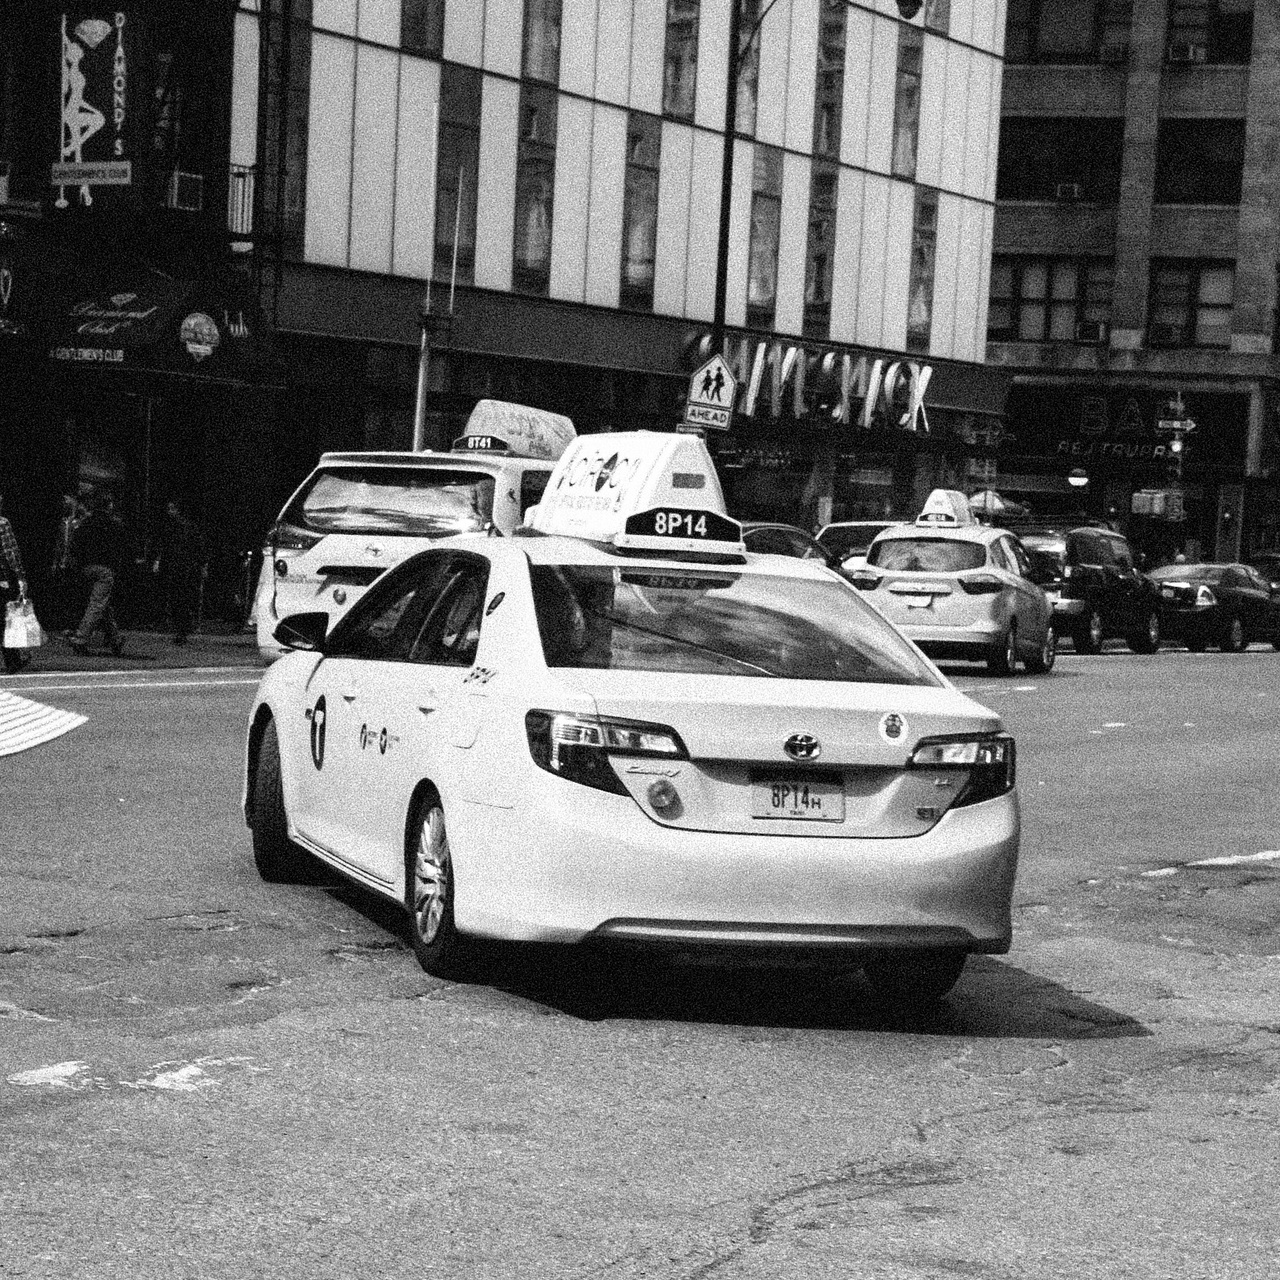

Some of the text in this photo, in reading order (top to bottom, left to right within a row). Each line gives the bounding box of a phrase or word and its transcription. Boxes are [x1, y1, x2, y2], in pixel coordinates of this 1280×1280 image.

[104, 348, 124, 363] CLUB
[688, 408, 728, 425] AHEAD
[654, 512, 708, 537] 8P14
